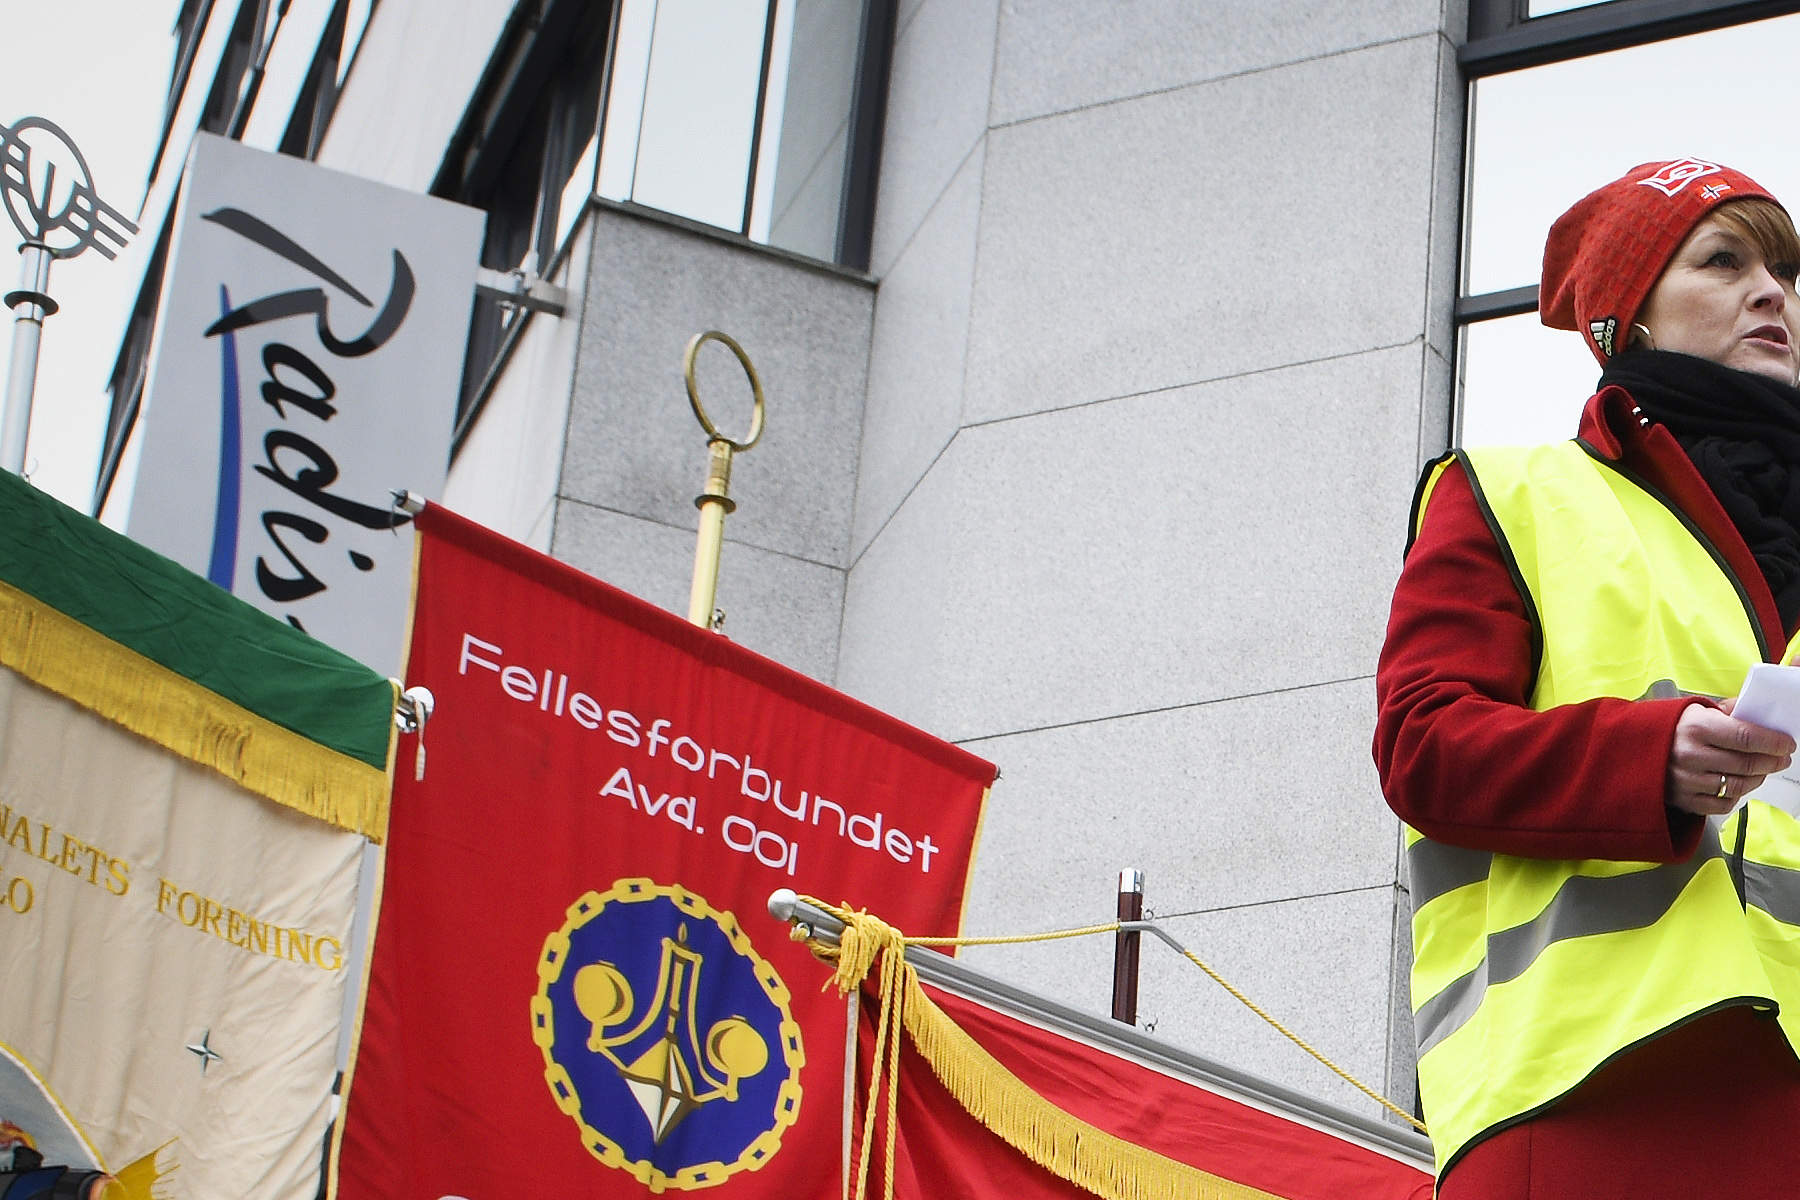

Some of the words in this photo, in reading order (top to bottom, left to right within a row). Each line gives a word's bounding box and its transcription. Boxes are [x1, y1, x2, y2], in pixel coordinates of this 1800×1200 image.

[200, 207, 416, 640] Radis
[459, 632, 939, 873] Fellesforbundet
[600, 767, 704, 834] Avd.
[156, 878, 343, 971] FORENING
